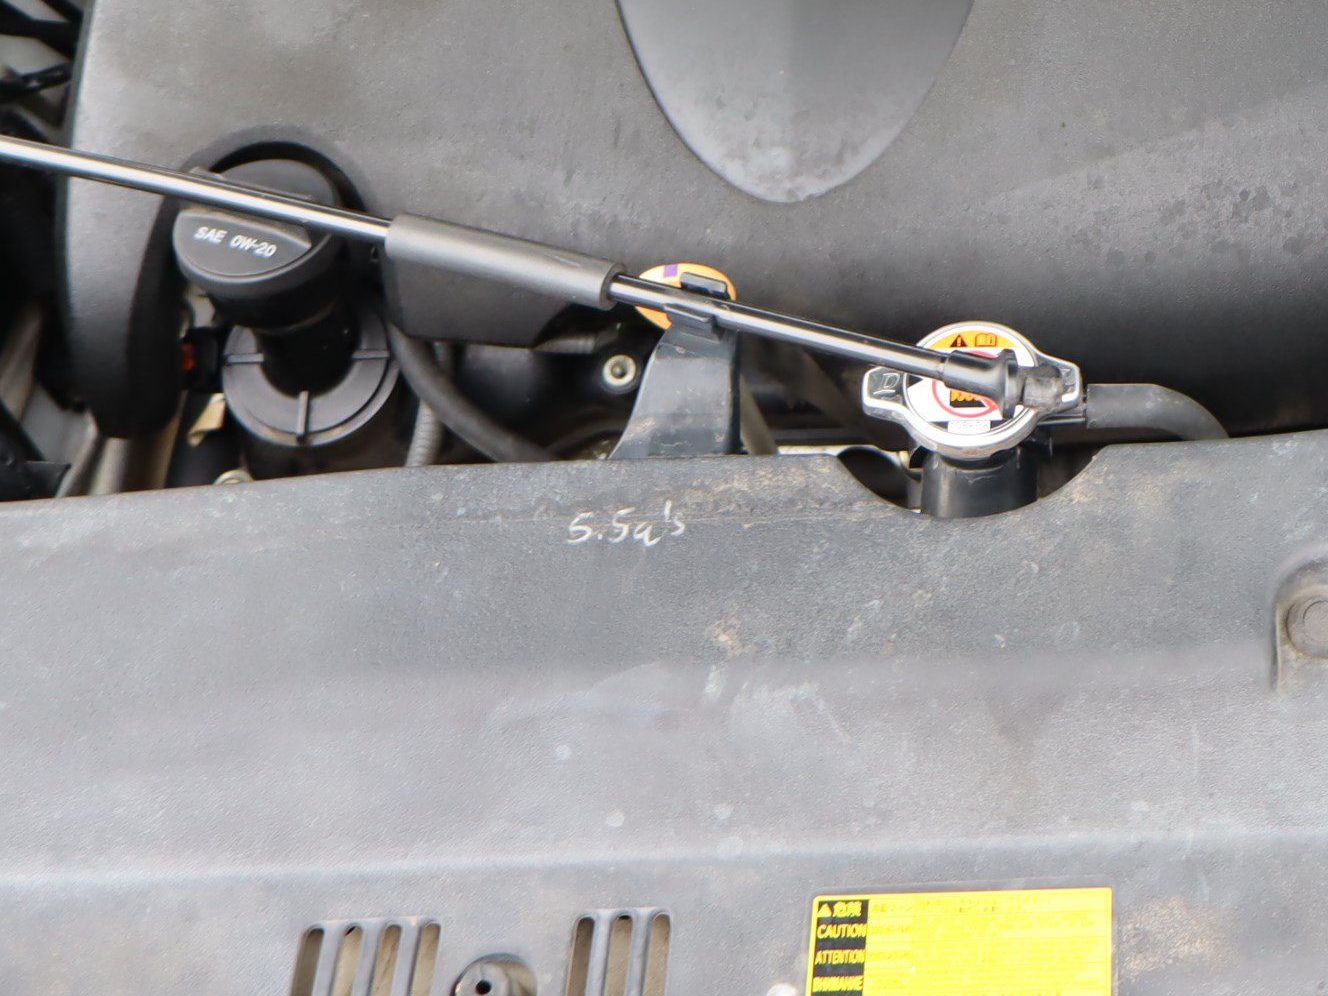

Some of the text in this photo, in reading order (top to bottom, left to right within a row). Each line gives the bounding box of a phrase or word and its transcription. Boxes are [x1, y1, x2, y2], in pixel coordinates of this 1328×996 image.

[194, 226, 278, 258] SAE 0W-20
[816, 923, 867, 939] CAUTION
[814, 948, 866, 965] ATTENTION
